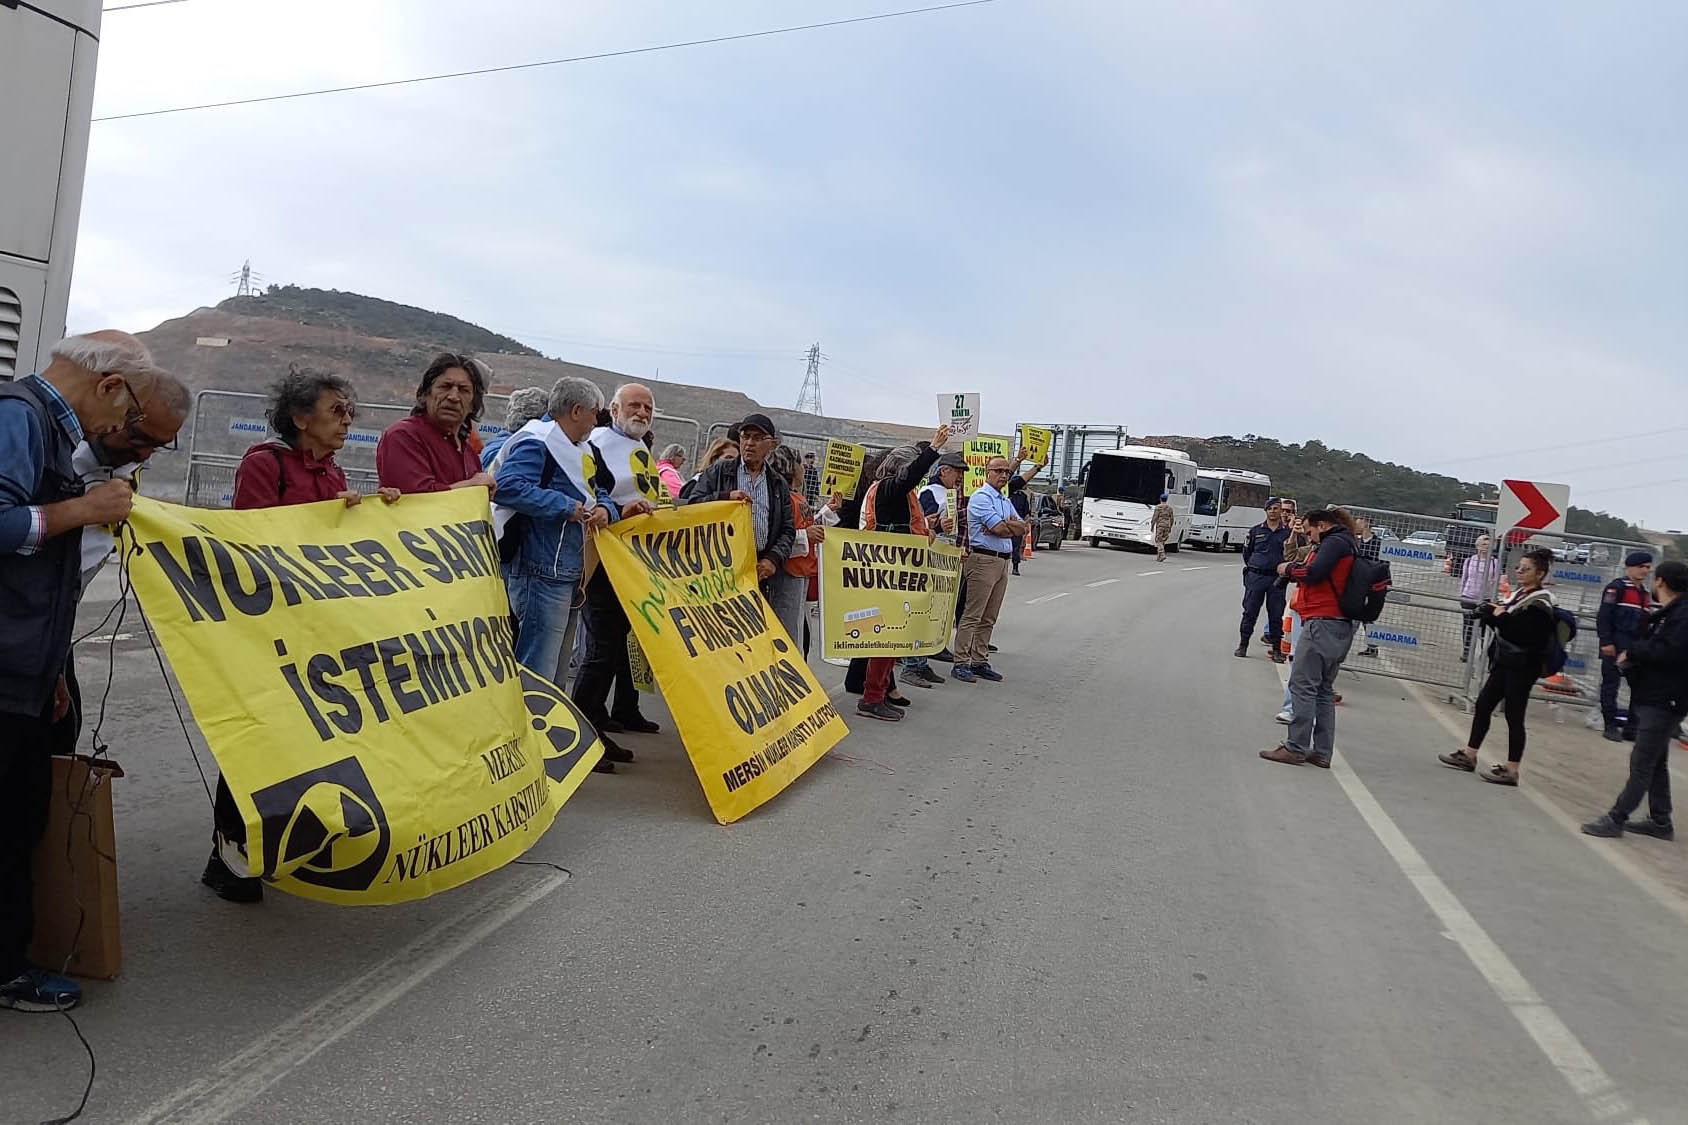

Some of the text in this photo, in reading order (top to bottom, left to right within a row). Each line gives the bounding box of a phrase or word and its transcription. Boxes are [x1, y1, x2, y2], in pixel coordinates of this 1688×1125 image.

[954, 394, 965, 409] 27
[231, 421, 266, 433] JANDARMA
[478, 424, 506, 434] JANDA
[631, 521, 733, 580] AKKUYU
[841, 541, 924, 568] AKKUYU
[1382, 546, 1434, 561] JANDARMA
[145, 519, 504, 623] NÜKLEER SANT
[842, 561, 929, 593] NÜKLEER
[1367, 631, 1418, 646] JANDARMA
[273, 607, 520, 742] İSTEMİYOR
[722, 751, 769, 793] MERSİN
[383, 813, 495, 885] NÜKLEER
